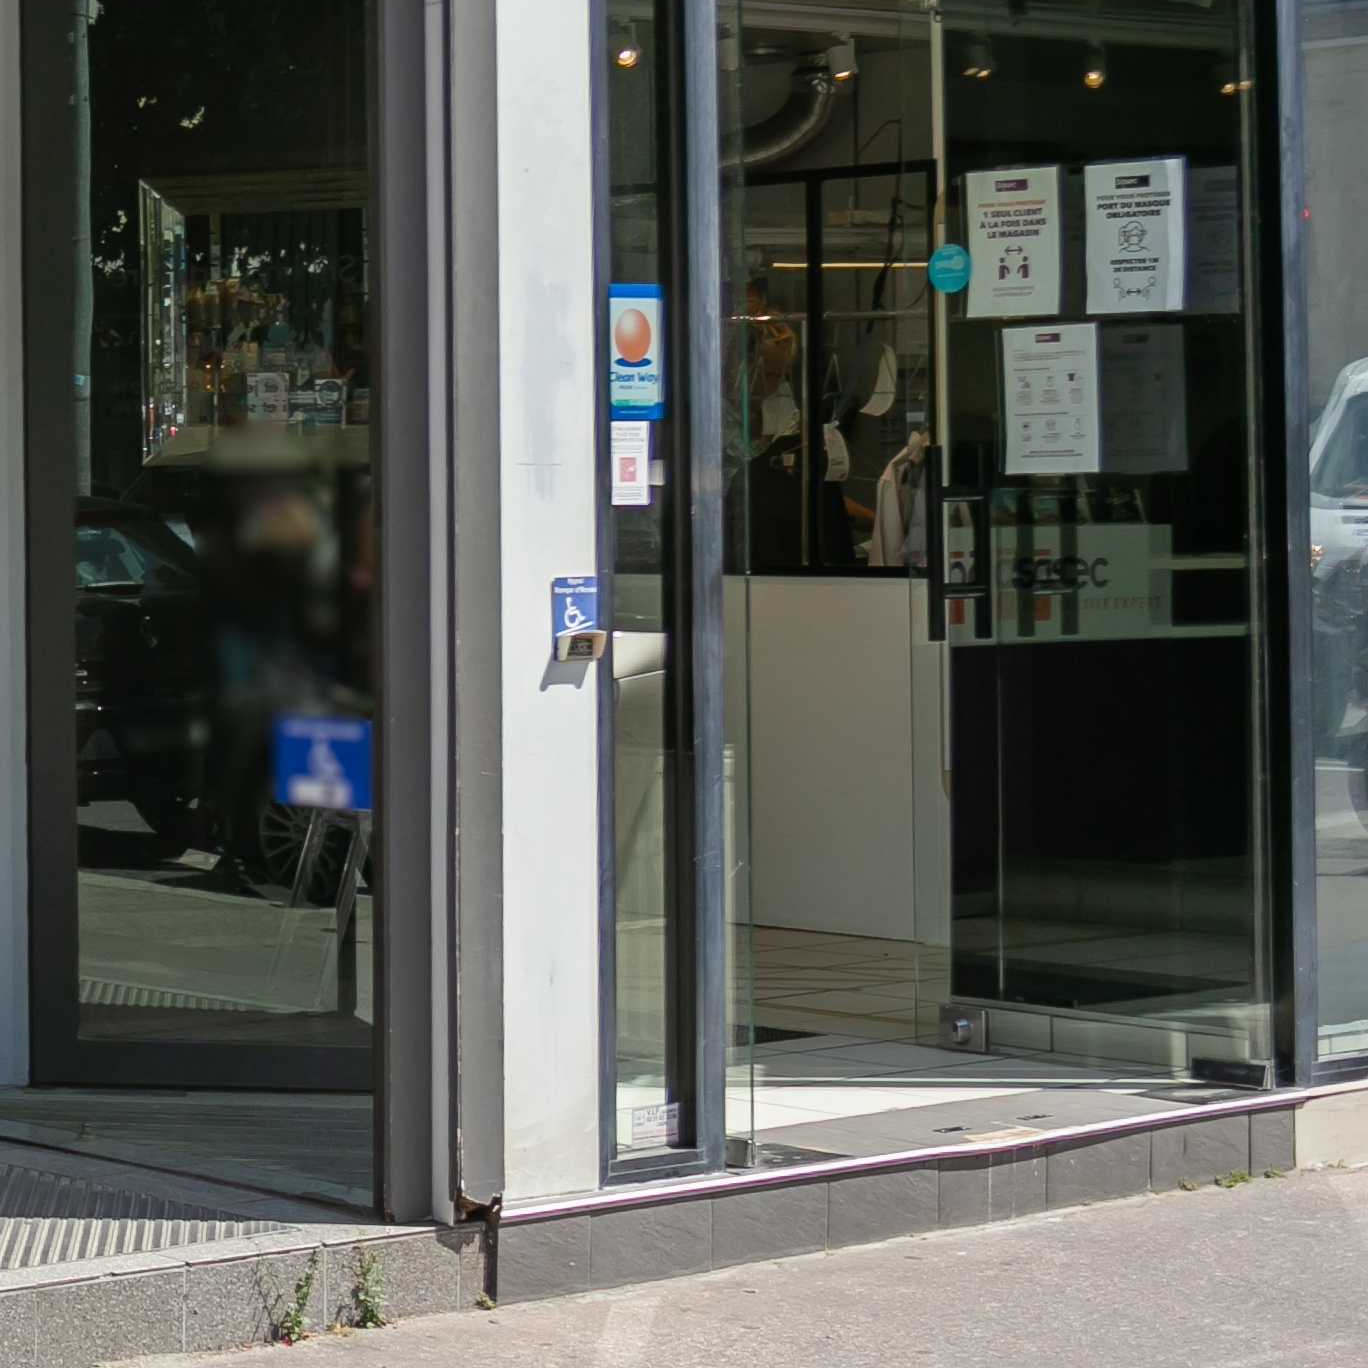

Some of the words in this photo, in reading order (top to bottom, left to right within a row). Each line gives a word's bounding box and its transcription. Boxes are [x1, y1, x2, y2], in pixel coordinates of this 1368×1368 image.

[1135, 199, 1170, 207] MASQUE
[1013, 208, 1043, 217] CLIENT
[1022, 218, 1047, 226] DANS
[999, 229, 1040, 238] MAGASIN
